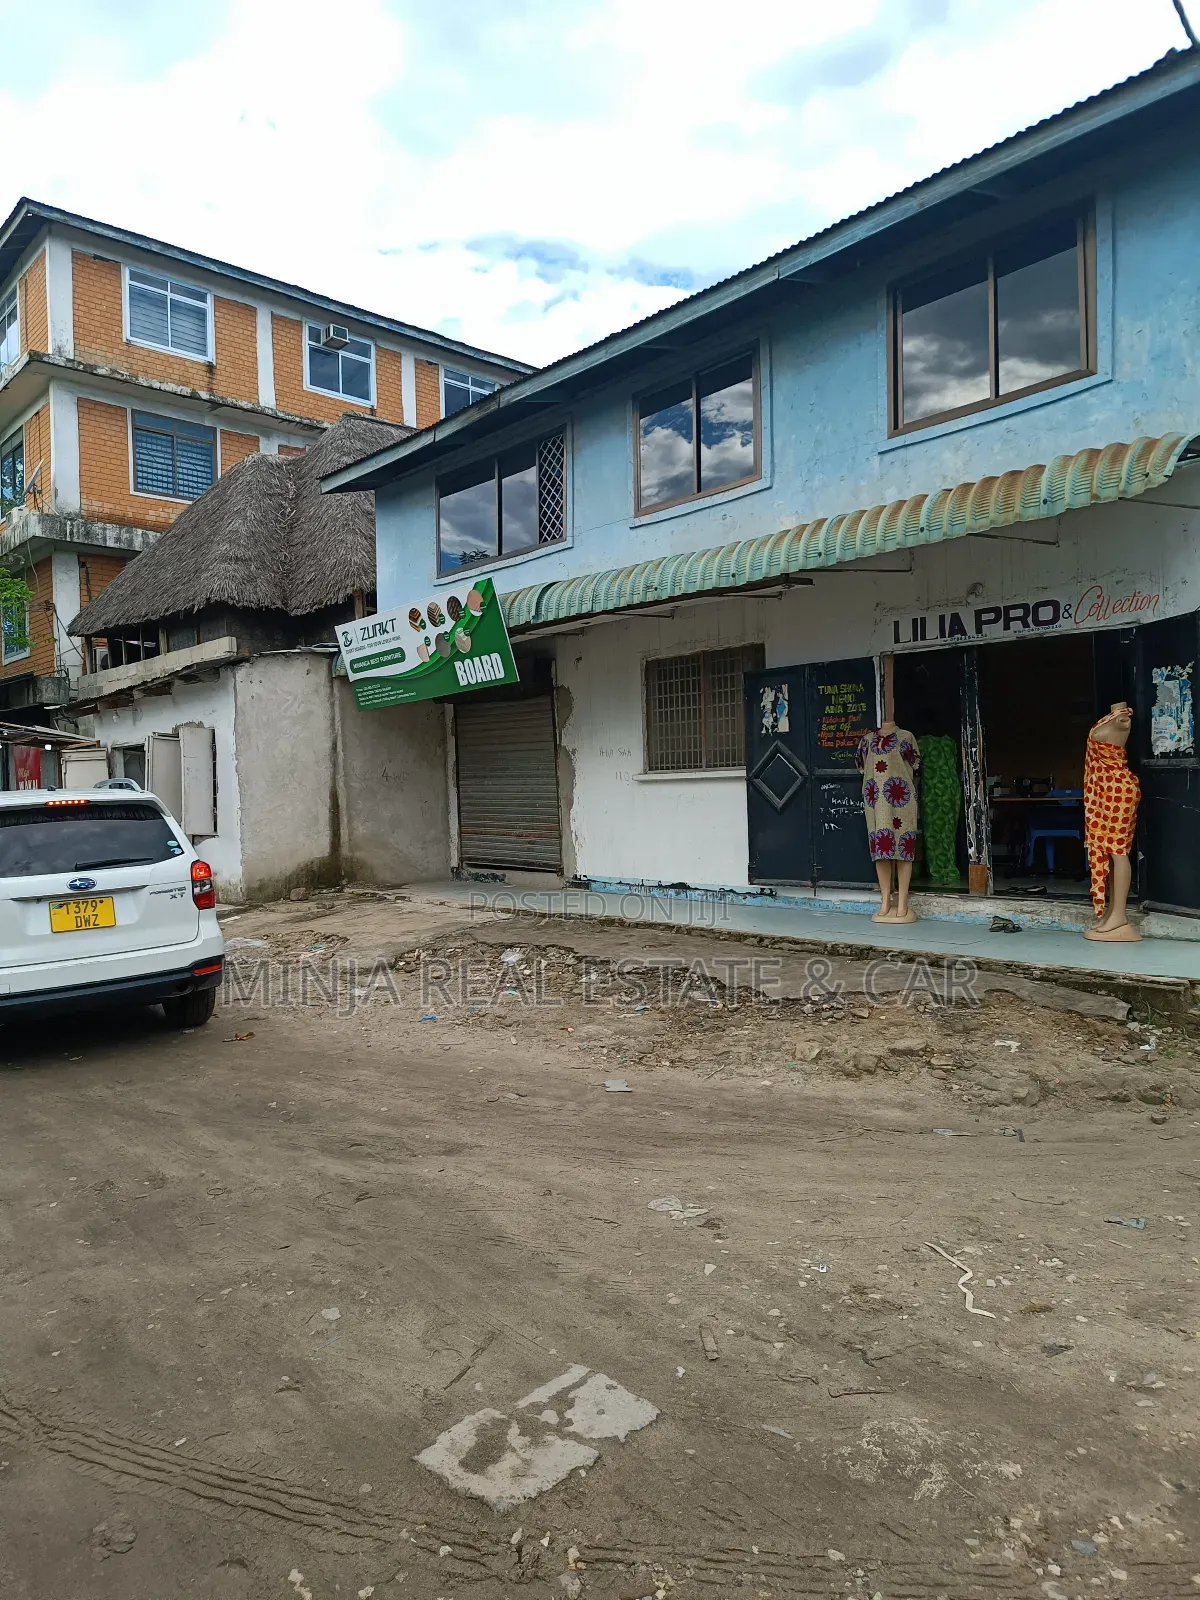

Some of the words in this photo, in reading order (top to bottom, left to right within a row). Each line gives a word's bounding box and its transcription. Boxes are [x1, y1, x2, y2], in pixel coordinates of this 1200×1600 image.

[893, 612, 968, 645] LILIA
[974, 599, 1061, 635] PRO
[1062, 604, 1073, 620] &
[1073, 585, 1160, 625] Collection
[359, 617, 397, 642] ZURKT
[454, 653, 505, 686] BOARD
[64, 900, 98, 915] T379
[75, 914, 100, 928] DWZ
